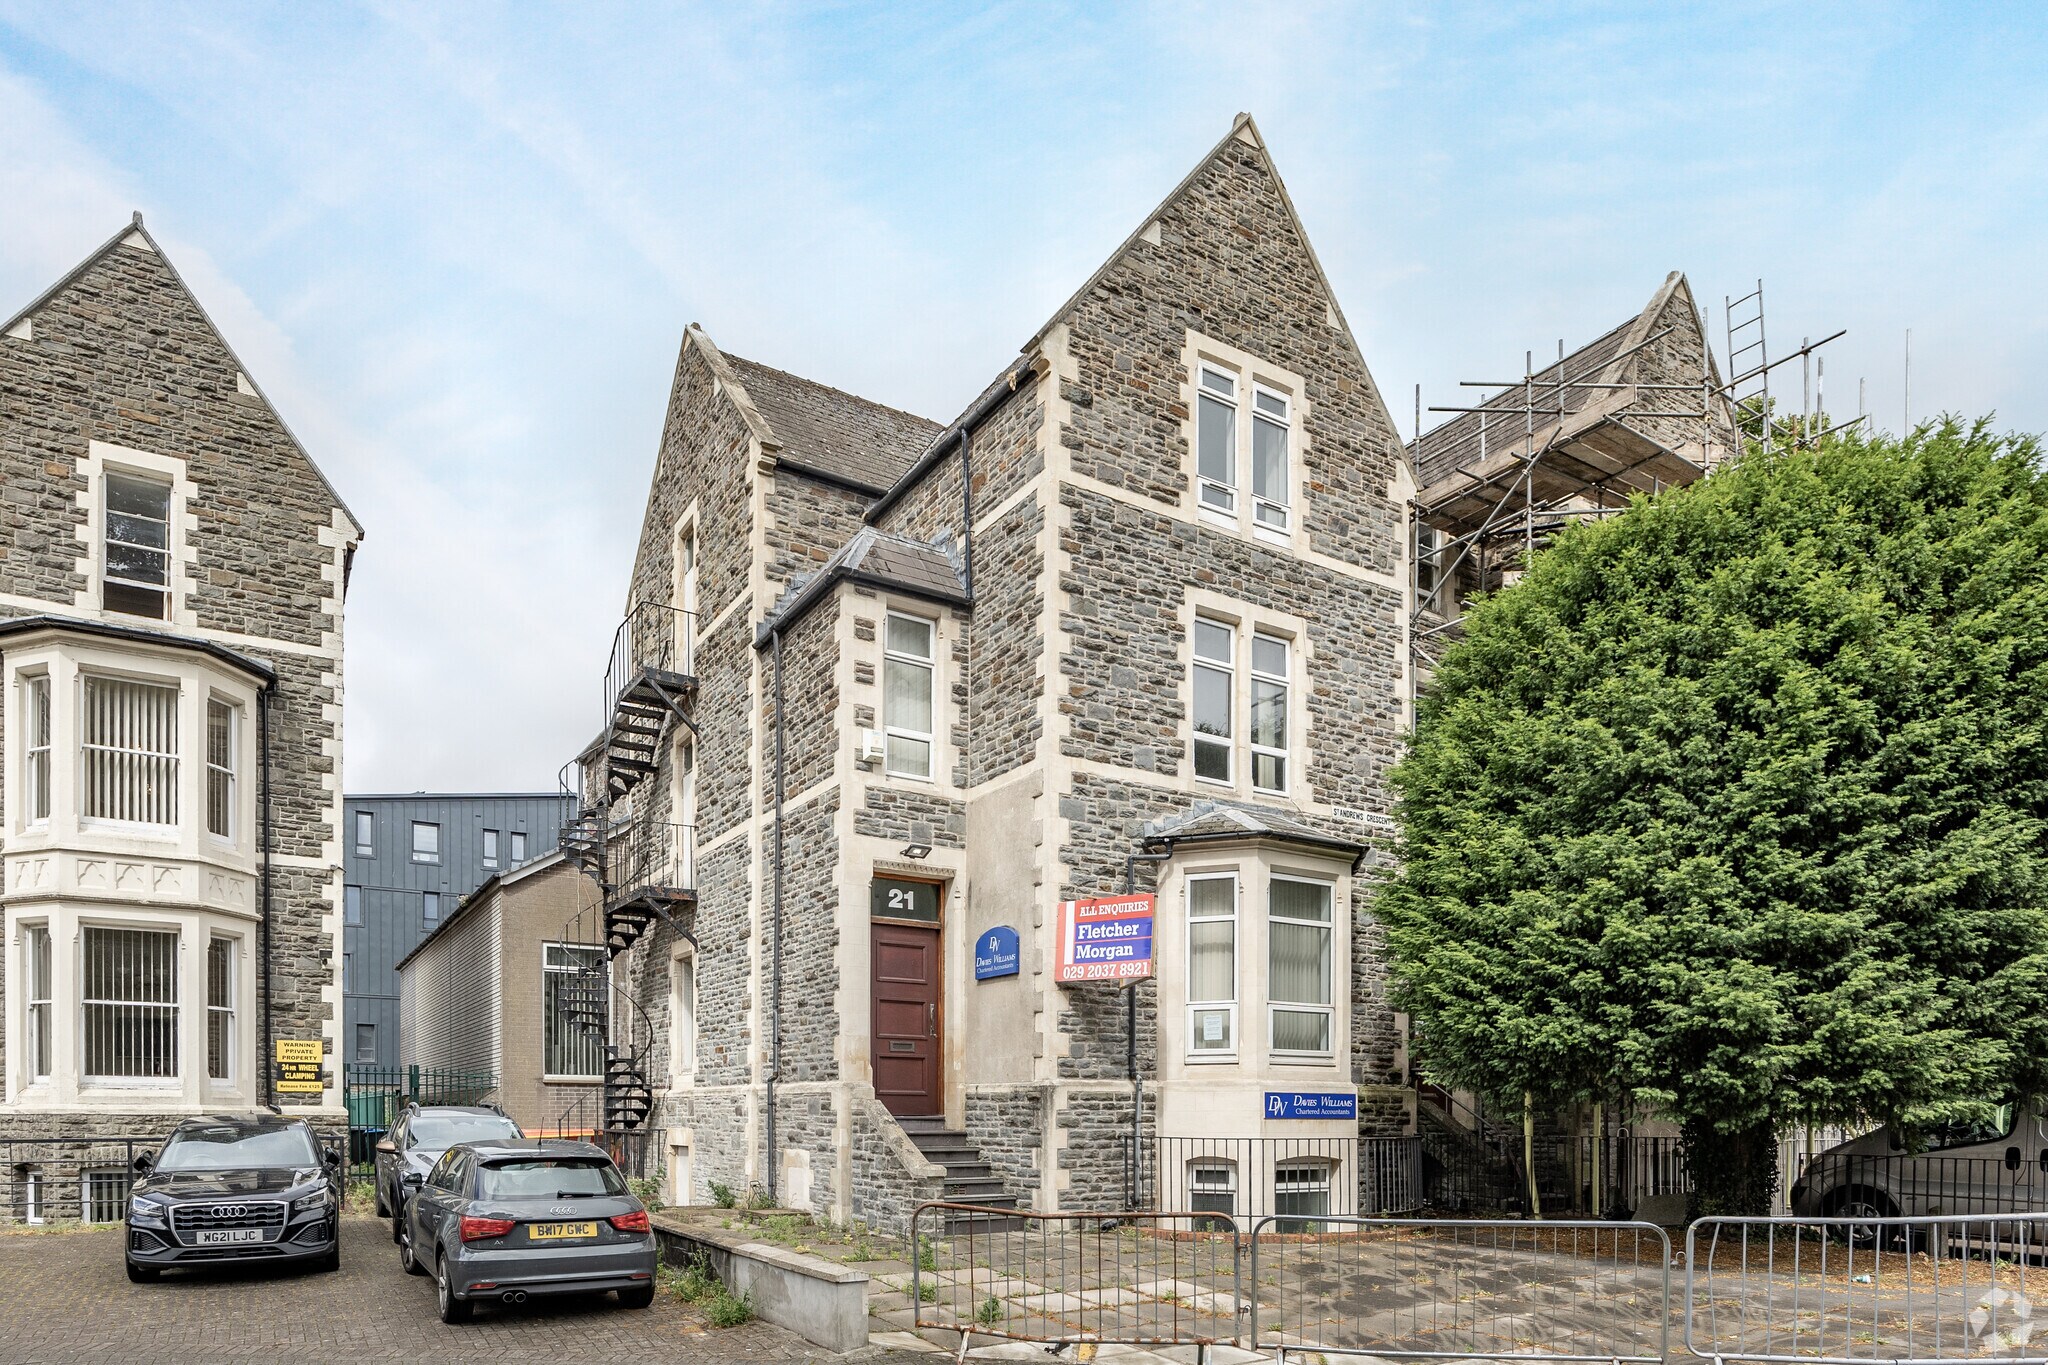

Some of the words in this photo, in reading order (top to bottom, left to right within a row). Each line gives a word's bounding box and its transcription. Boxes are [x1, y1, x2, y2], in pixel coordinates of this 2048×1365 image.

[1340, 809, 1364, 821] ANDREWS
[1366, 814, 1391, 826] CRESCENT
[888, 888, 914, 911] 21
[1080, 906, 1097, 917] ALL
[1098, 901, 1149, 916] ENQUIRIES
[1078, 922, 1140, 940] Fletcher
[1076, 944, 1134, 960] Morgan
[976, 966, 993, 974] Chartered
[1063, 965, 1085, 979] 029
[1088, 964, 1117, 978] 2037
[1119, 961, 1149, 976] 8921
[284, 1072, 316, 1080] CLAMPING
[298, 1064, 319, 1072] WHEEL
[1268, 1095, 1289, 1116] DW
[204, 1231, 230, 1242] WG21
[233, 1230, 256, 1241] LJC
[537, 1224, 564, 1236] BW17
[567, 1223, 590, 1235] GWC
